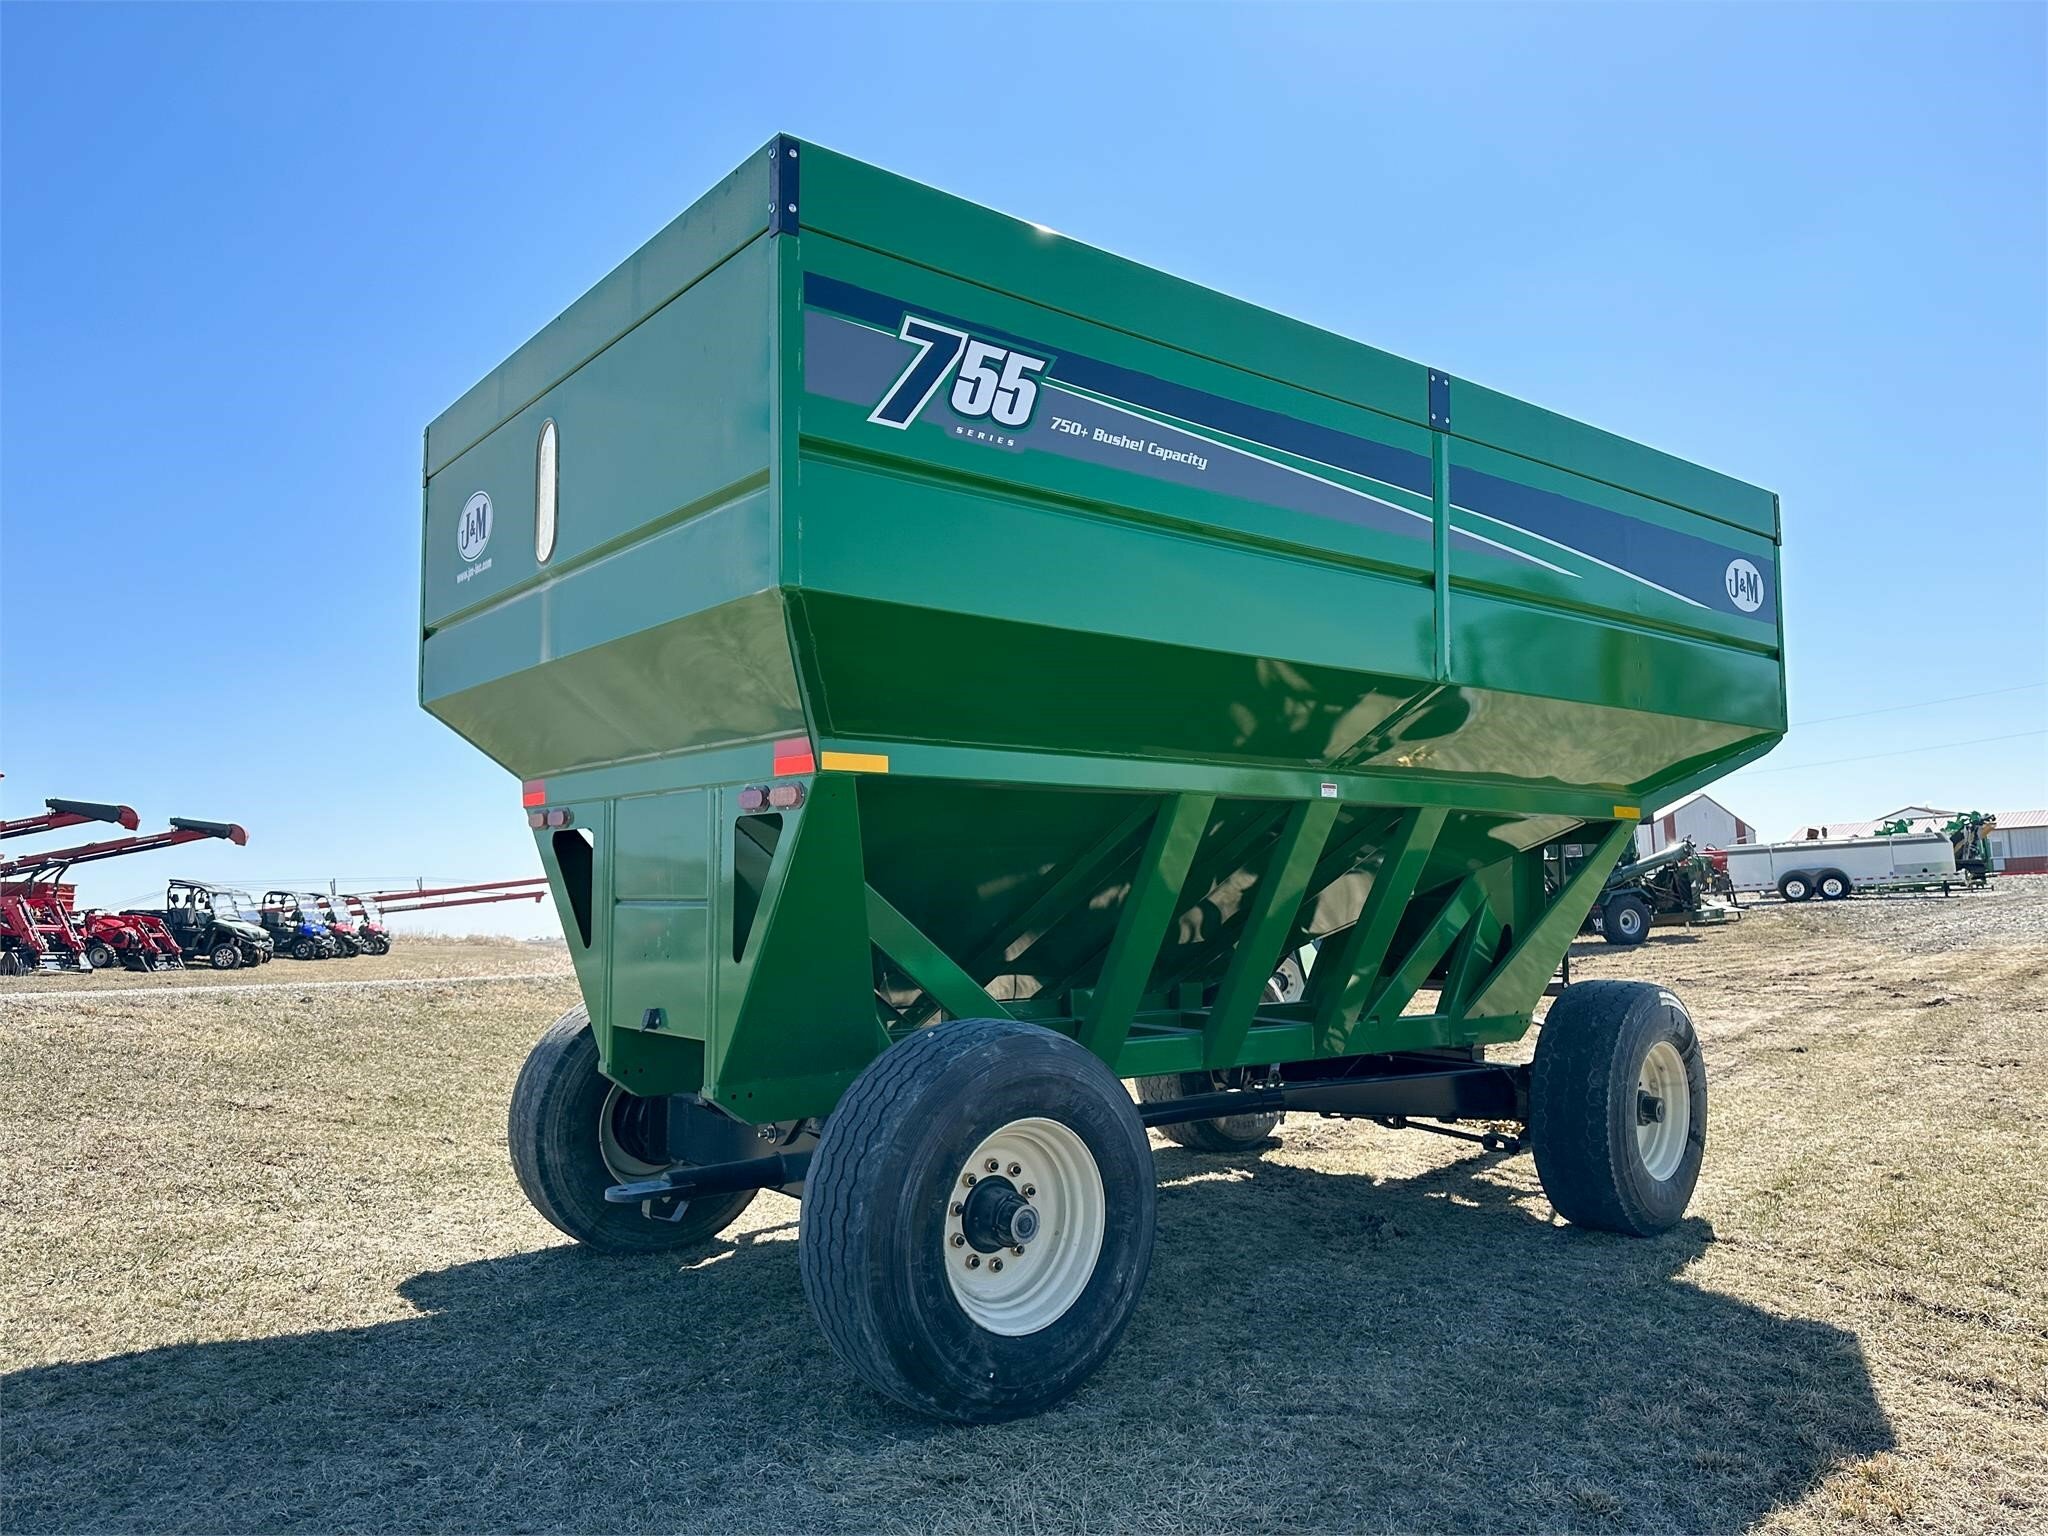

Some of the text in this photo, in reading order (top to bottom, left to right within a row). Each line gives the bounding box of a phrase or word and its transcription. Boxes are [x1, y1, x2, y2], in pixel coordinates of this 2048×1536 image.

[867, 315, 1046, 430] 755
[955, 426, 1015, 447] SERIES
[1050, 416, 1208, 470] 750+ Bushel Capacity
[461, 502, 487, 550] J&M
[1728, 567, 1759, 604] J&M
